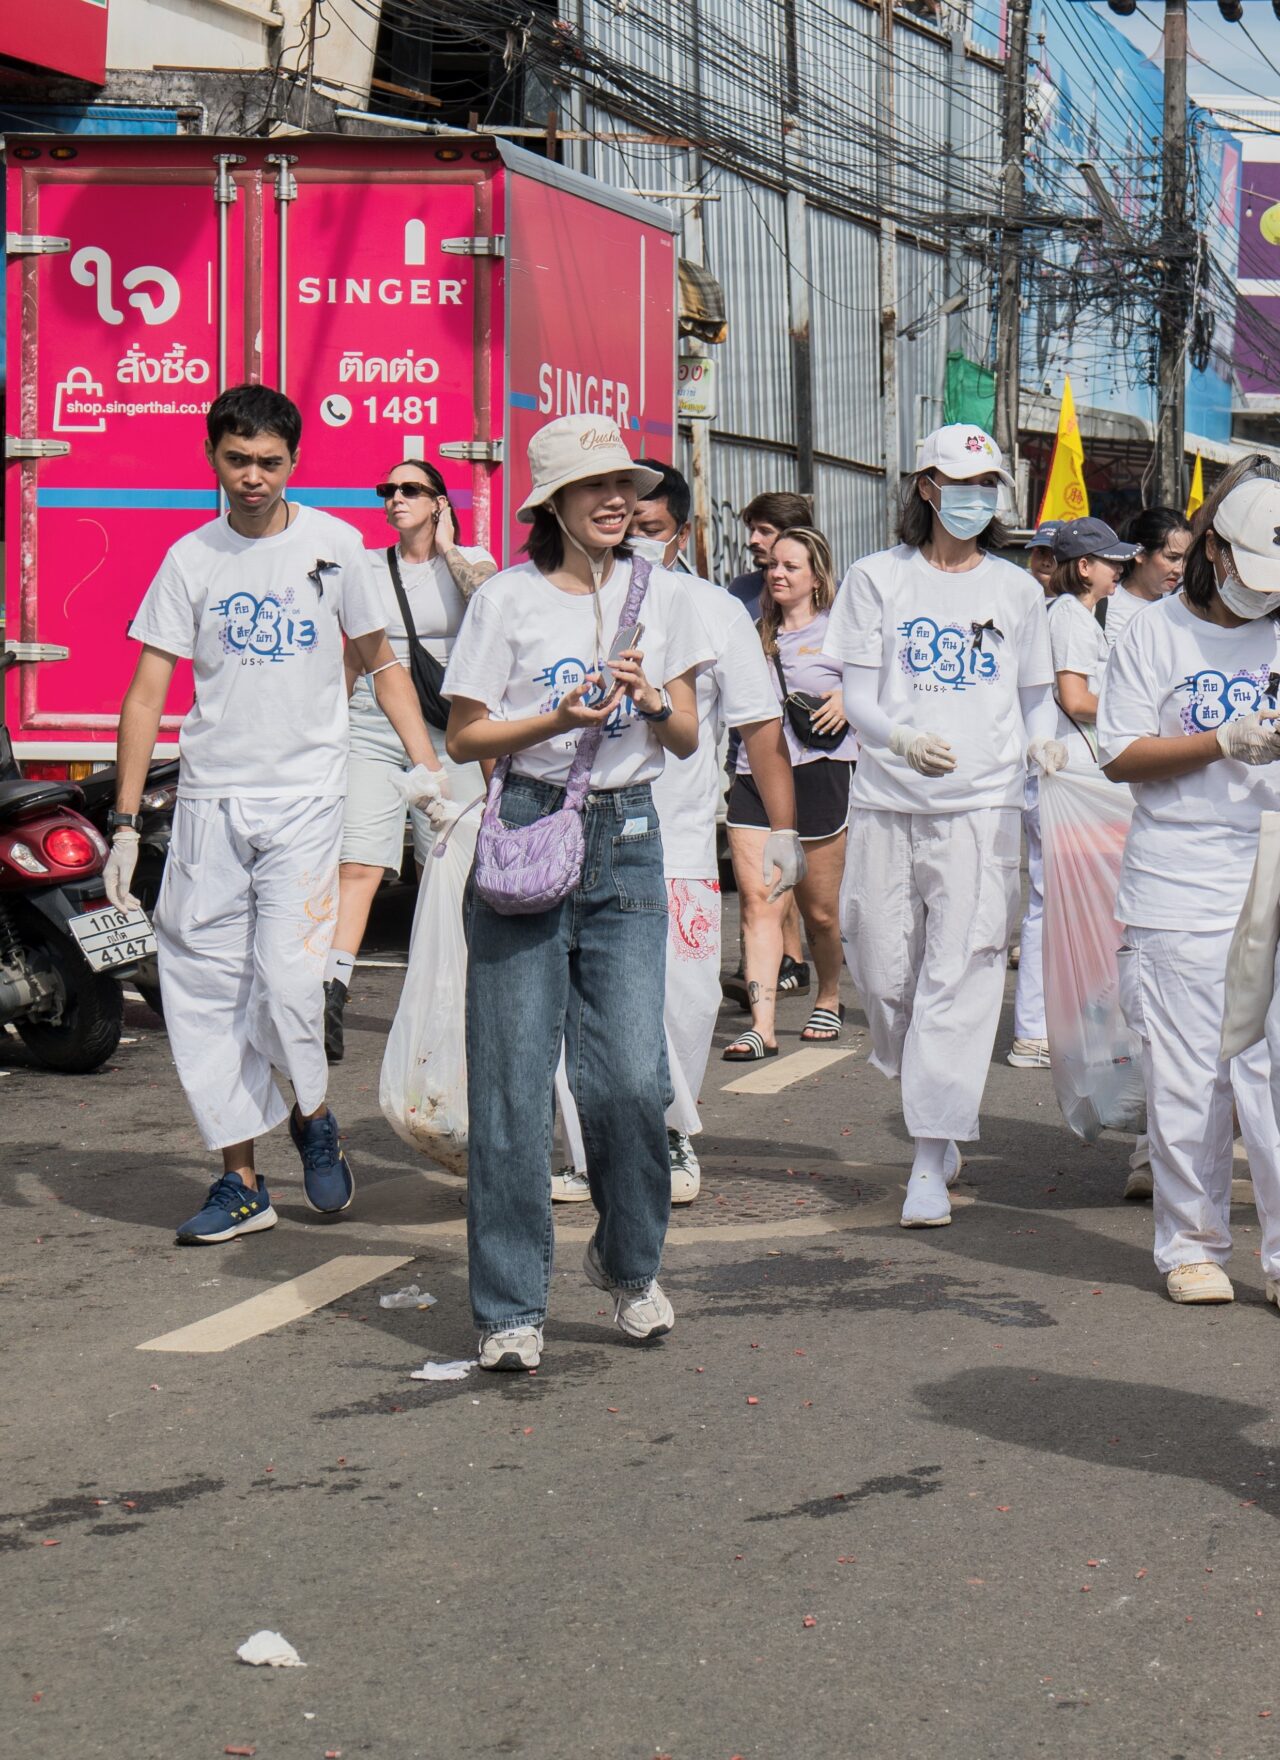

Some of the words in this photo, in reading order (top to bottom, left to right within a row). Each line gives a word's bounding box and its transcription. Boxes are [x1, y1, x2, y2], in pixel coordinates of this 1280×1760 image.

[70, 246, 181, 325] ใจ
[298, 277, 463, 305] SINGER
[116, 343, 210, 384] สั่งซื้อ
[338, 349, 440, 383] ติดต่อ
[363, 395, 438, 425] 1481
[539, 362, 630, 430] SINGER
[101, 938, 148, 963] 4147
